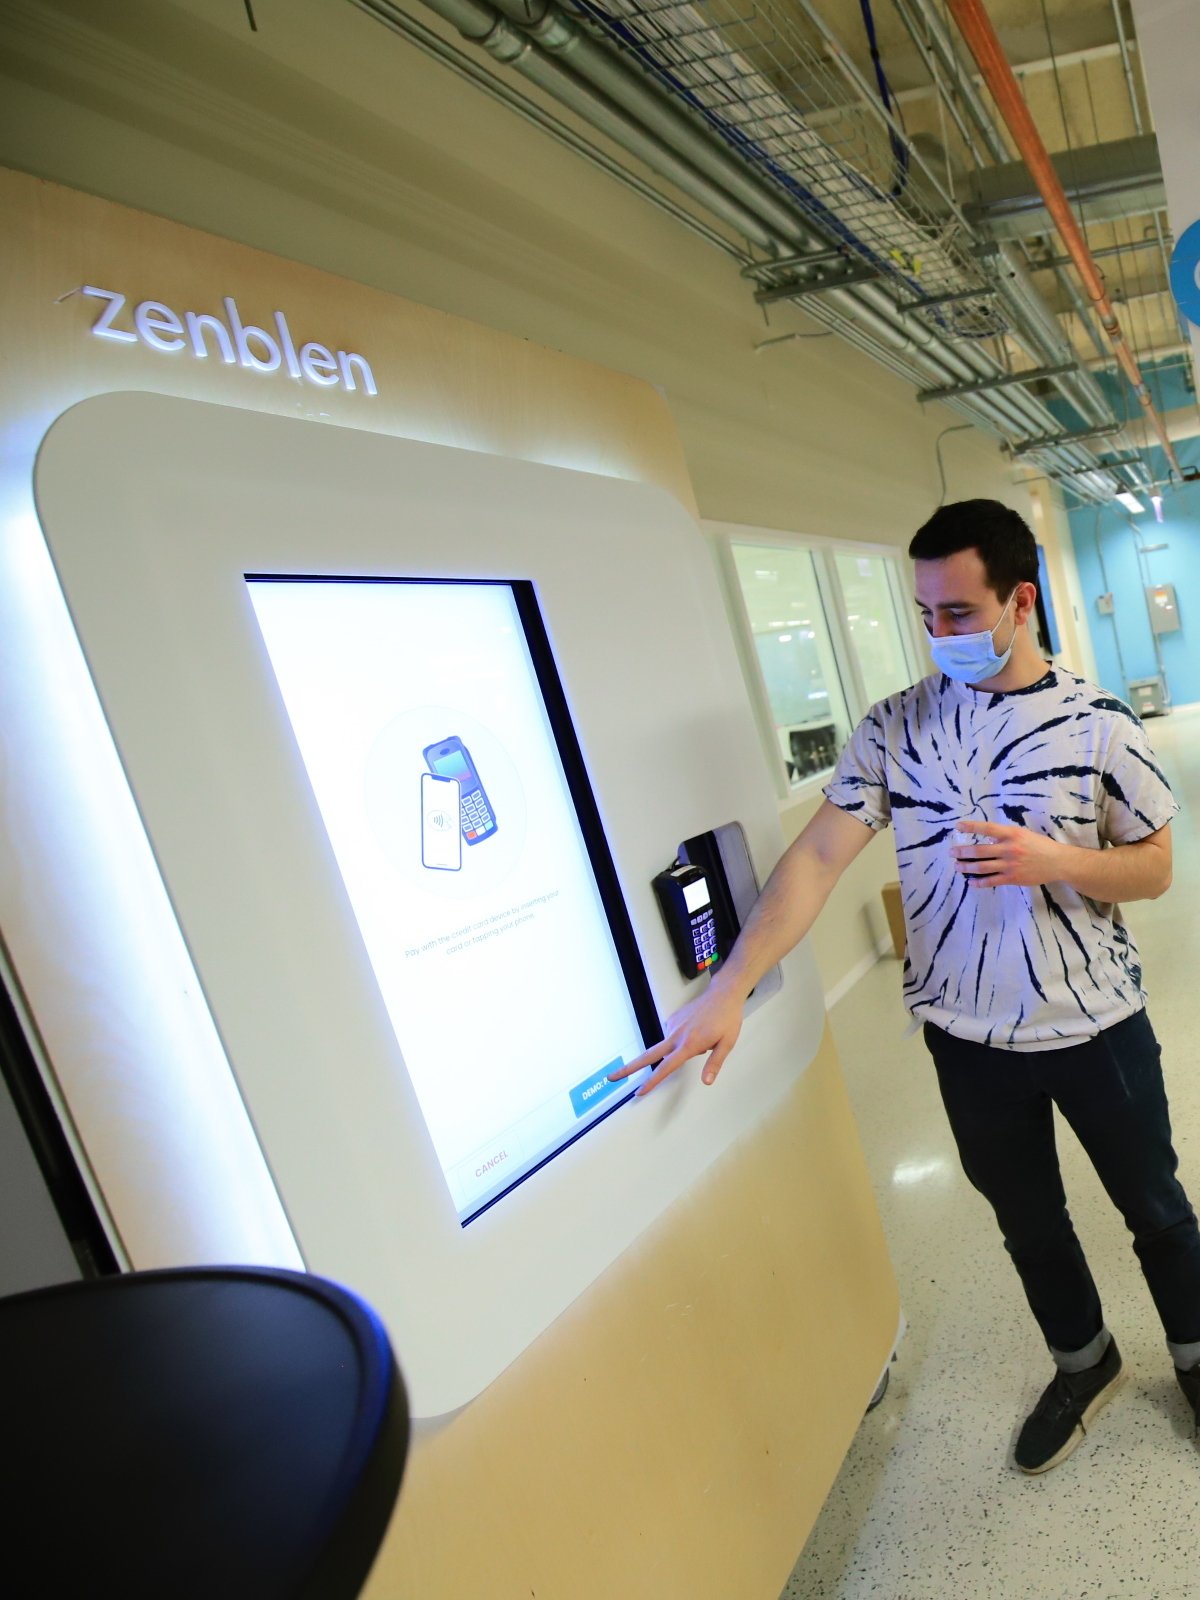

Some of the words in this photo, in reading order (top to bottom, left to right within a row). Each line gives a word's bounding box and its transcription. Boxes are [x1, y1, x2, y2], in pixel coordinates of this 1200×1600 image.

[82, 285, 378, 395] zenblen
[404, 949, 420, 958] Pay
[421, 940, 437, 952] with
[438, 935, 450, 944] the
[451, 926, 472, 939] credit
[473, 918, 489, 930] card
[490, 909, 511, 923] device
[512, 906, 520, 914] by
[521, 895, 546, 909] inserting
[547, 890, 560, 901] your
[446, 943, 463, 955] card
[464, 940, 472, 948] or
[472, 928, 499, 944] tapping
[500, 921, 514, 934] your
[582, 1081, 604, 1100] DEMO:
[475, 1150, 508, 1178] CANCEL
